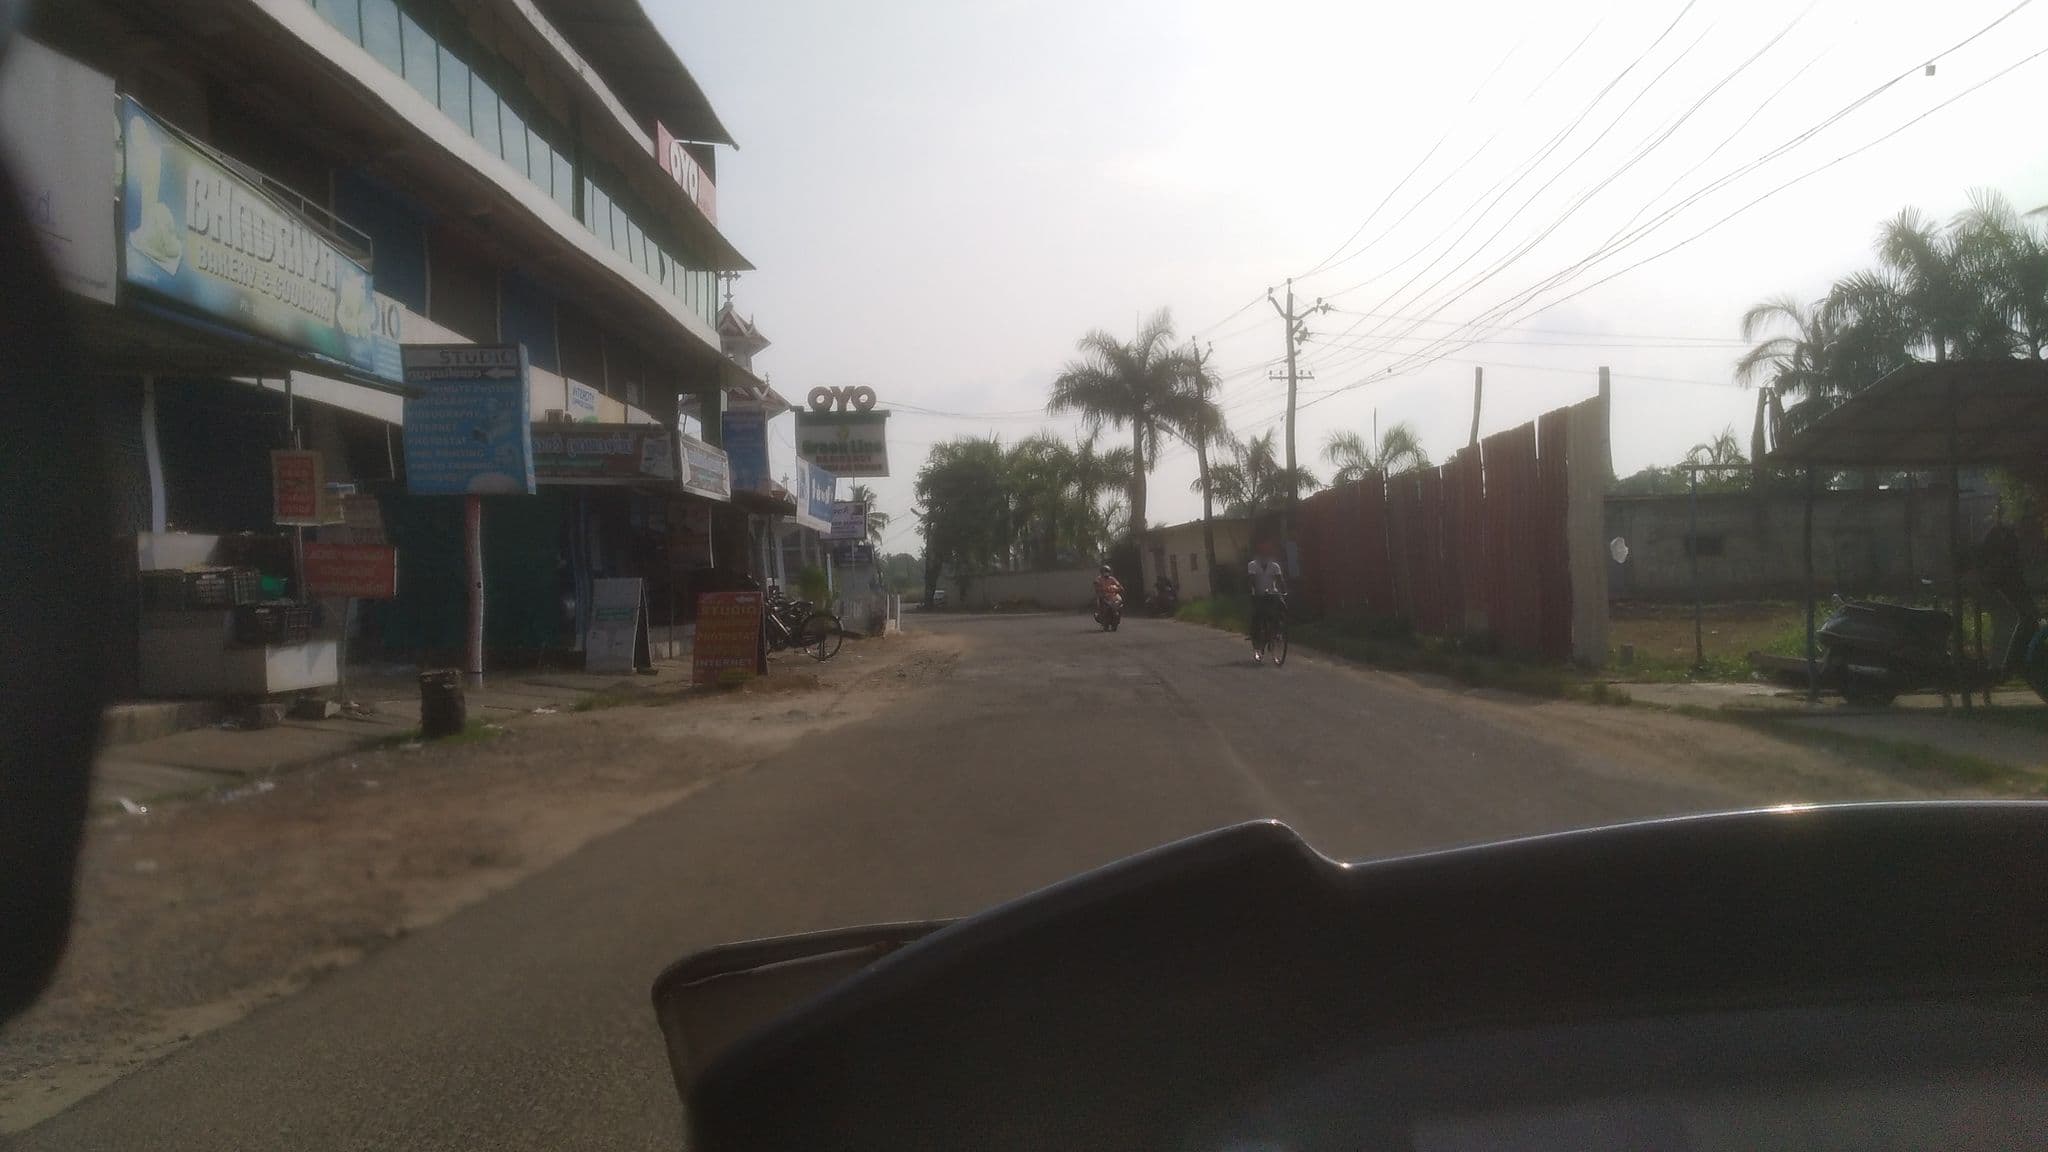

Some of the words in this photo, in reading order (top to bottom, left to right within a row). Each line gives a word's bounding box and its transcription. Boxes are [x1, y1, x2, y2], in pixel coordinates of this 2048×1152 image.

[669, 141, 700, 207] OYO
[198, 246, 257, 288] BAKERY
[439, 350, 514, 364] STUDIO
[808, 386, 877, 412] OYO
[407, 423, 457, 432] INTERNET
[701, 606, 757, 616] STUDIO
[696, 657, 753, 666] INTERNET
